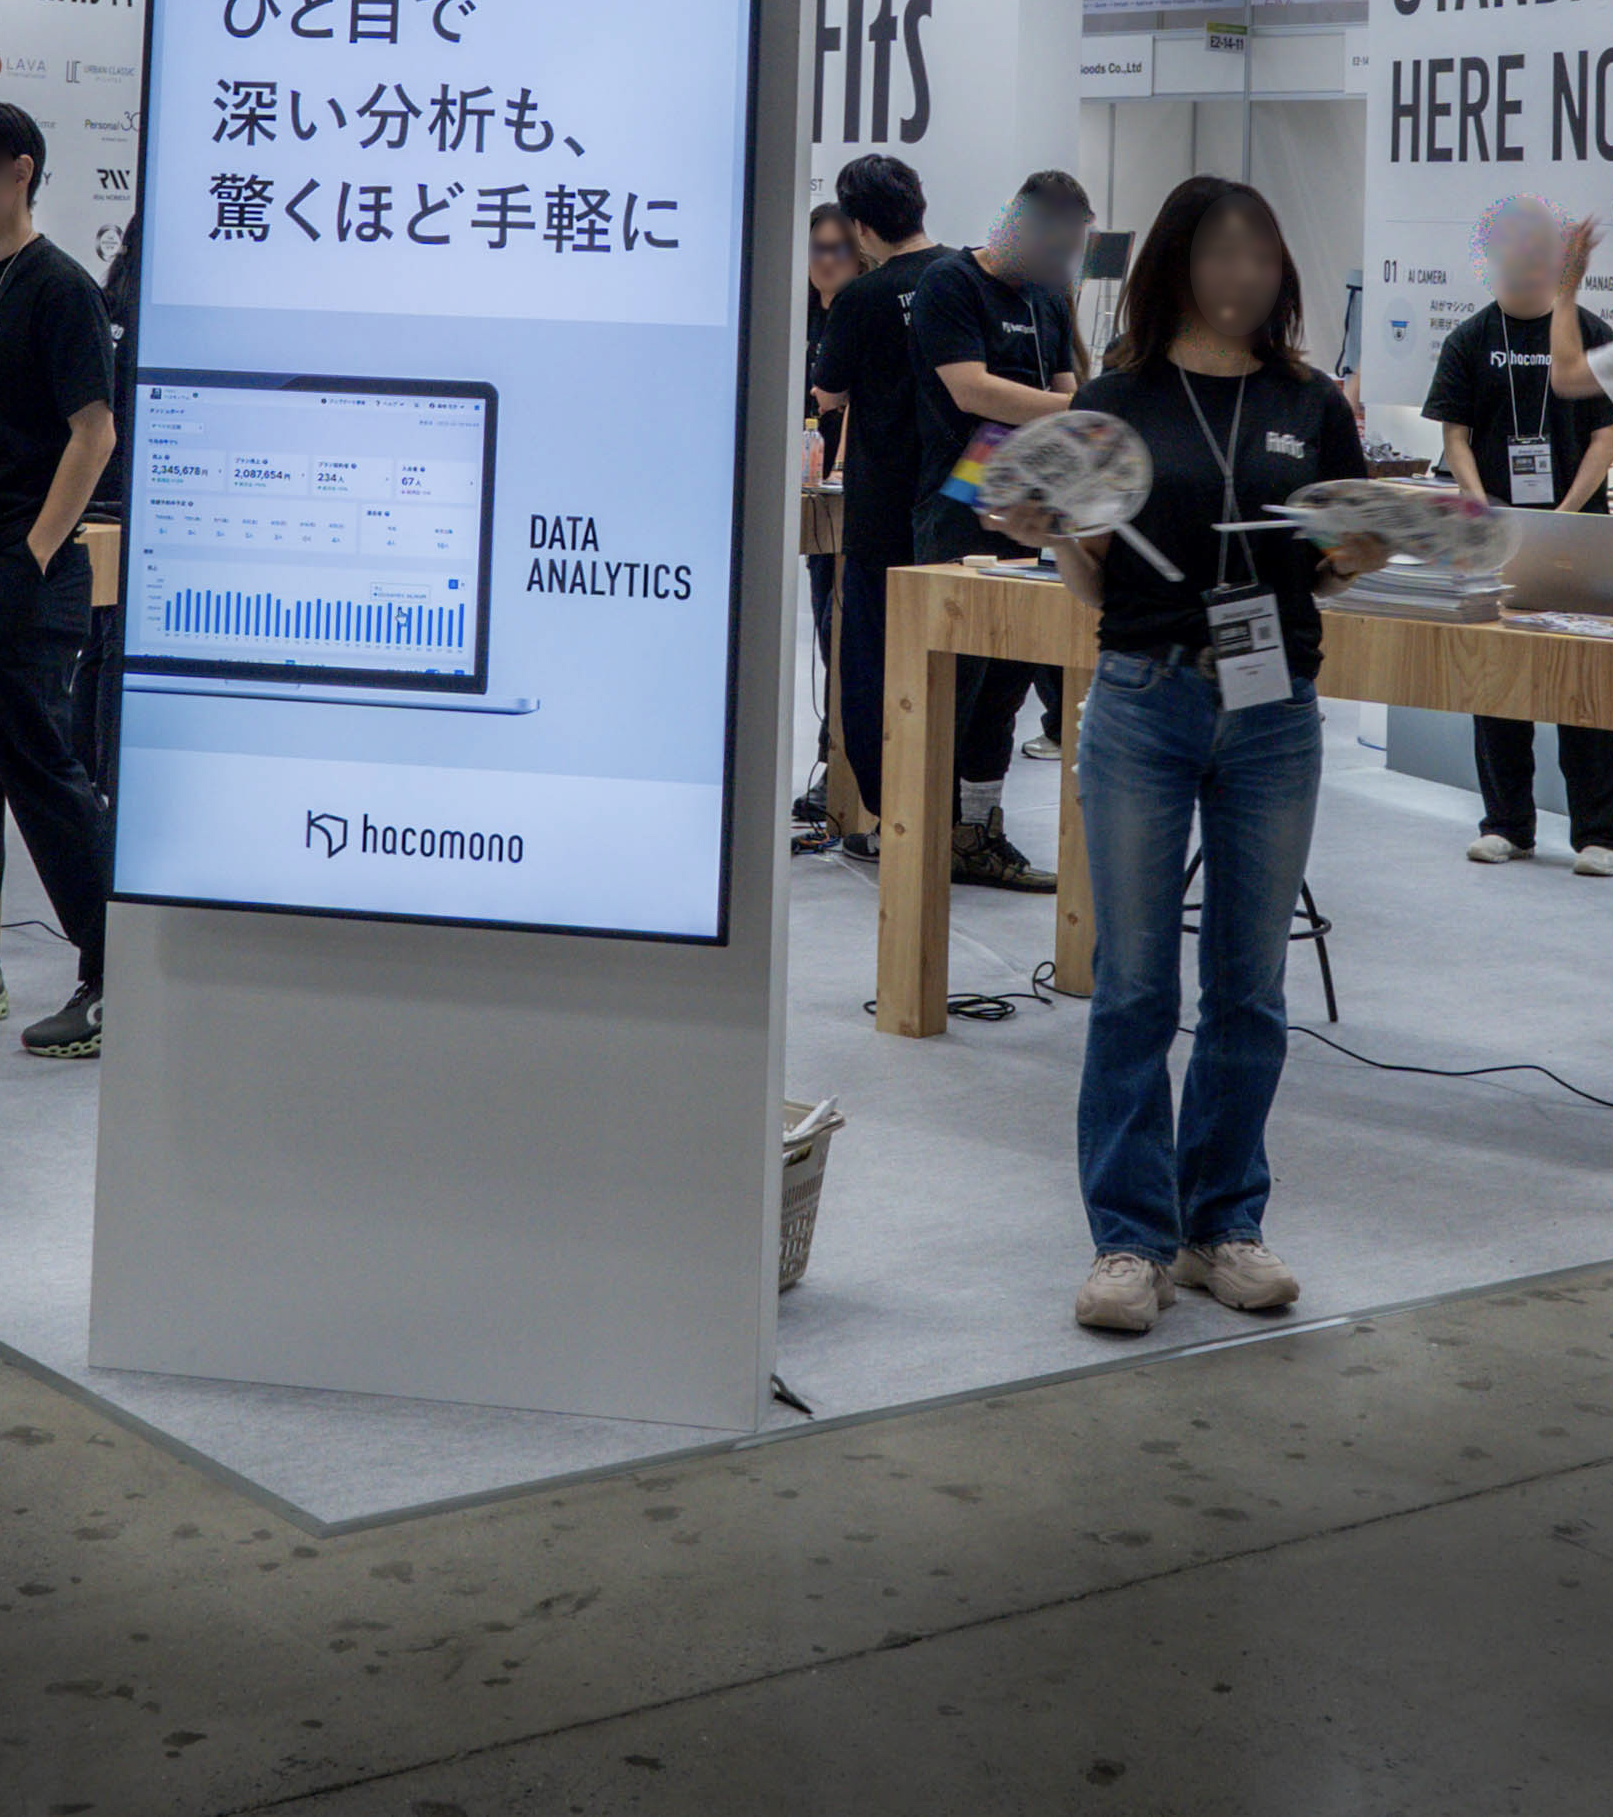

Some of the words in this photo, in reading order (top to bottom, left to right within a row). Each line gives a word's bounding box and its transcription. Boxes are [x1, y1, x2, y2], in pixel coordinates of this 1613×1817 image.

[6, 57, 47, 72] LAVA
[211, 77, 587, 158] 深い分析も、
[1389, 53, 1526, 164] HERE
[207, 173, 681, 254] 驚くほど手軽に
[1383, 259, 1398, 283] 01
[1417, 269, 1448, 285] CAMERA
[1510, 351, 1552, 367] hacomo
[529, 512, 600, 553] DATA
[525, 557, 693, 601] ANALYTICS
[361, 812, 525, 864] hacomono
